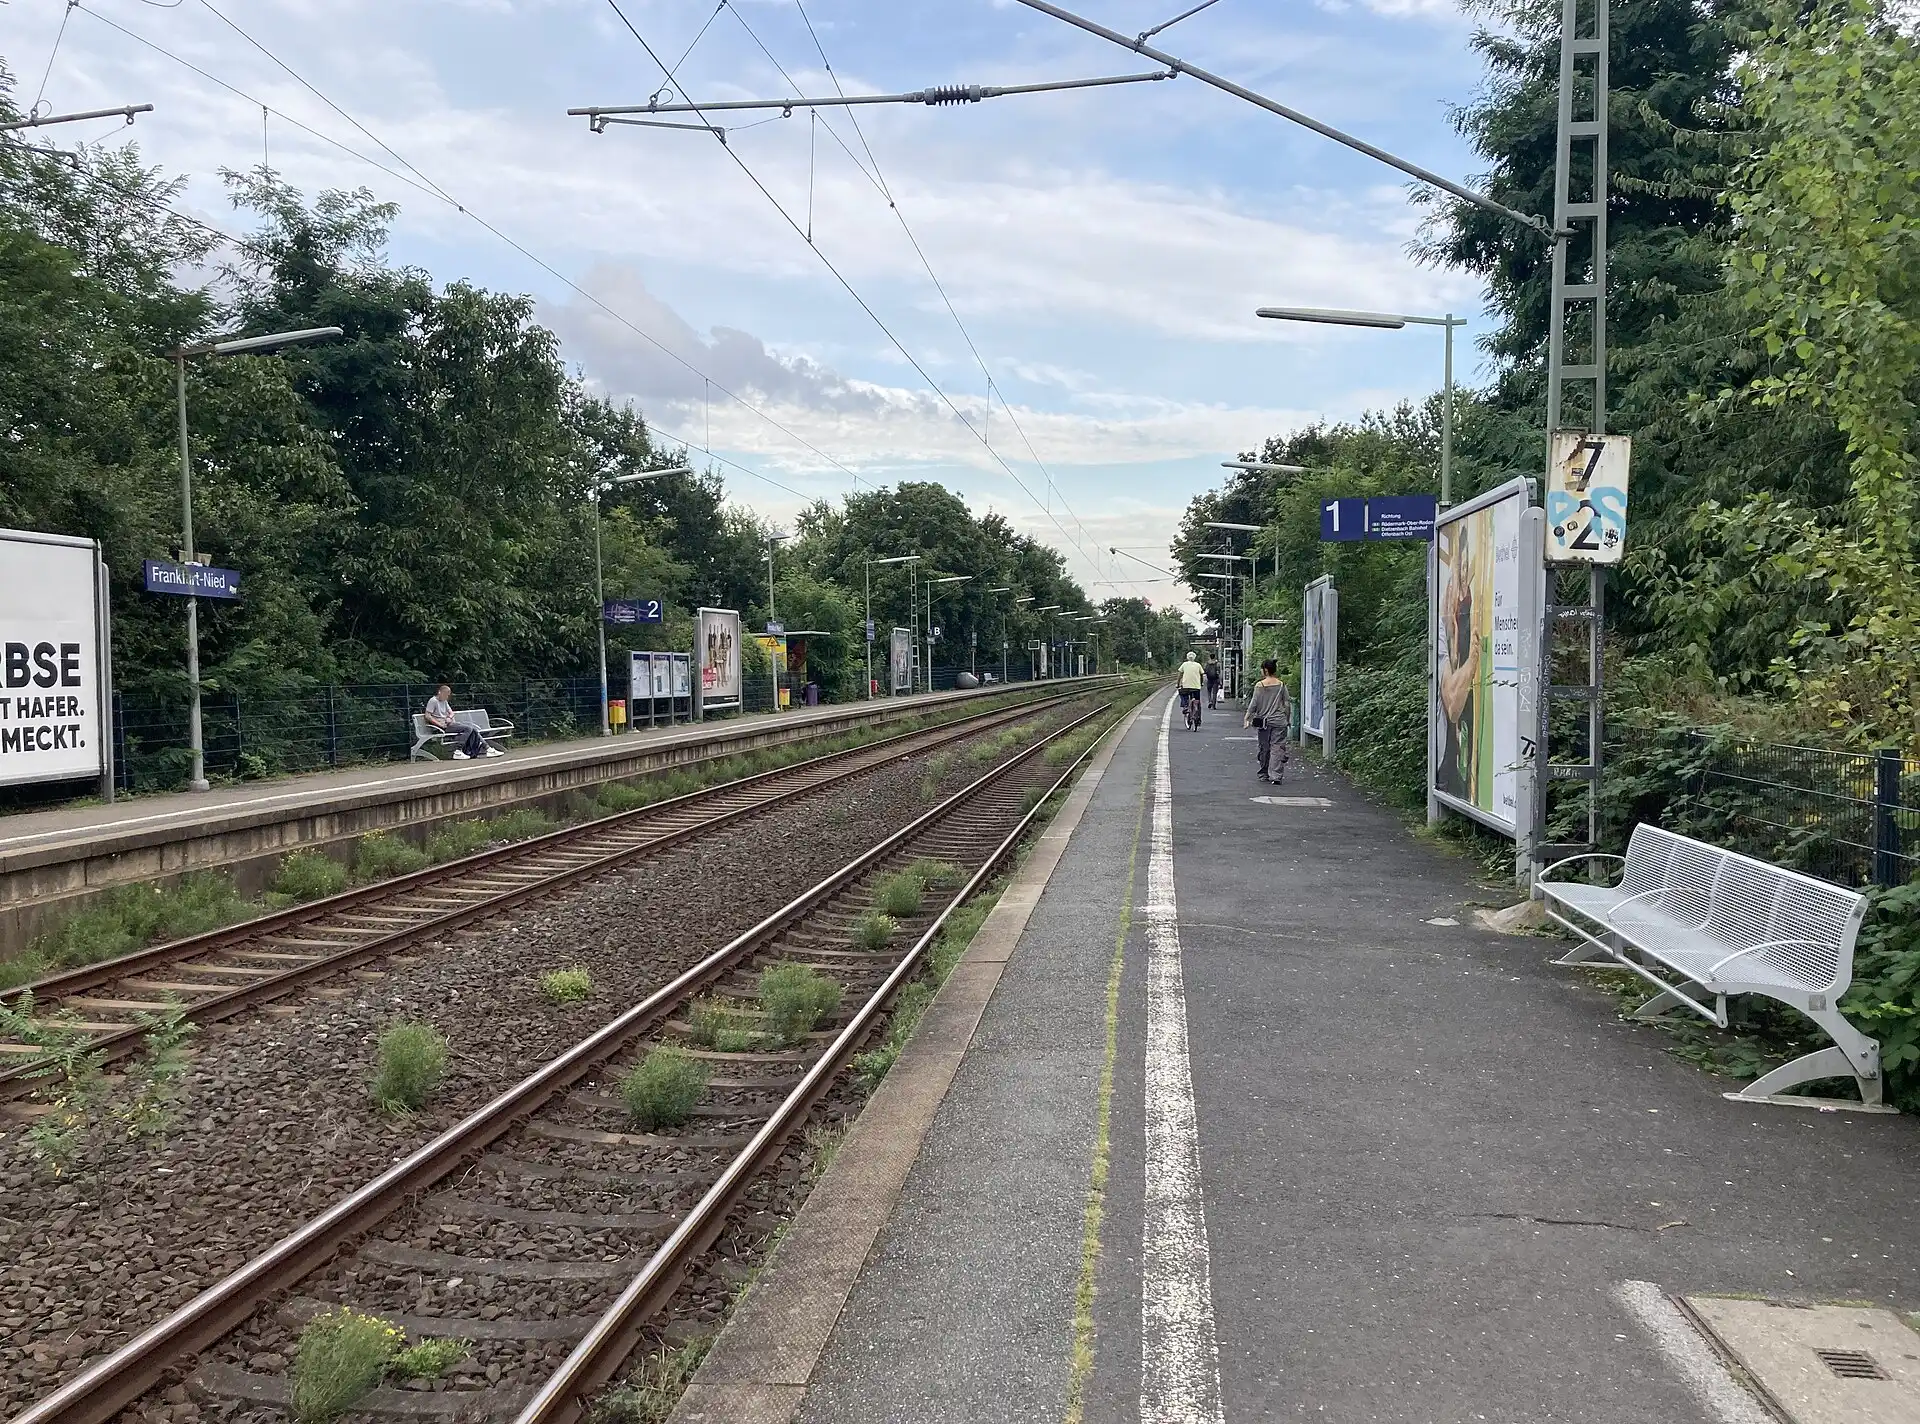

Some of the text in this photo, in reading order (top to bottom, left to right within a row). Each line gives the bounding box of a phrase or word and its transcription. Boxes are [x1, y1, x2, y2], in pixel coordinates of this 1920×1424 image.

[1576, 442, 1606, 492] 7
[1326, 501, 1339, 532] 1
[1569, 500, 1601, 550] 2
[648, 600, 659, 618] 2
[934, 626, 941, 636] B
[1495, 638, 1501, 655] da
[1501, 638, 1513, 655] sein.
[0, 641, 81, 688] BSE
[17, 696, 85, 718] HAFER.
[1, 724, 85, 753] MECKT.
